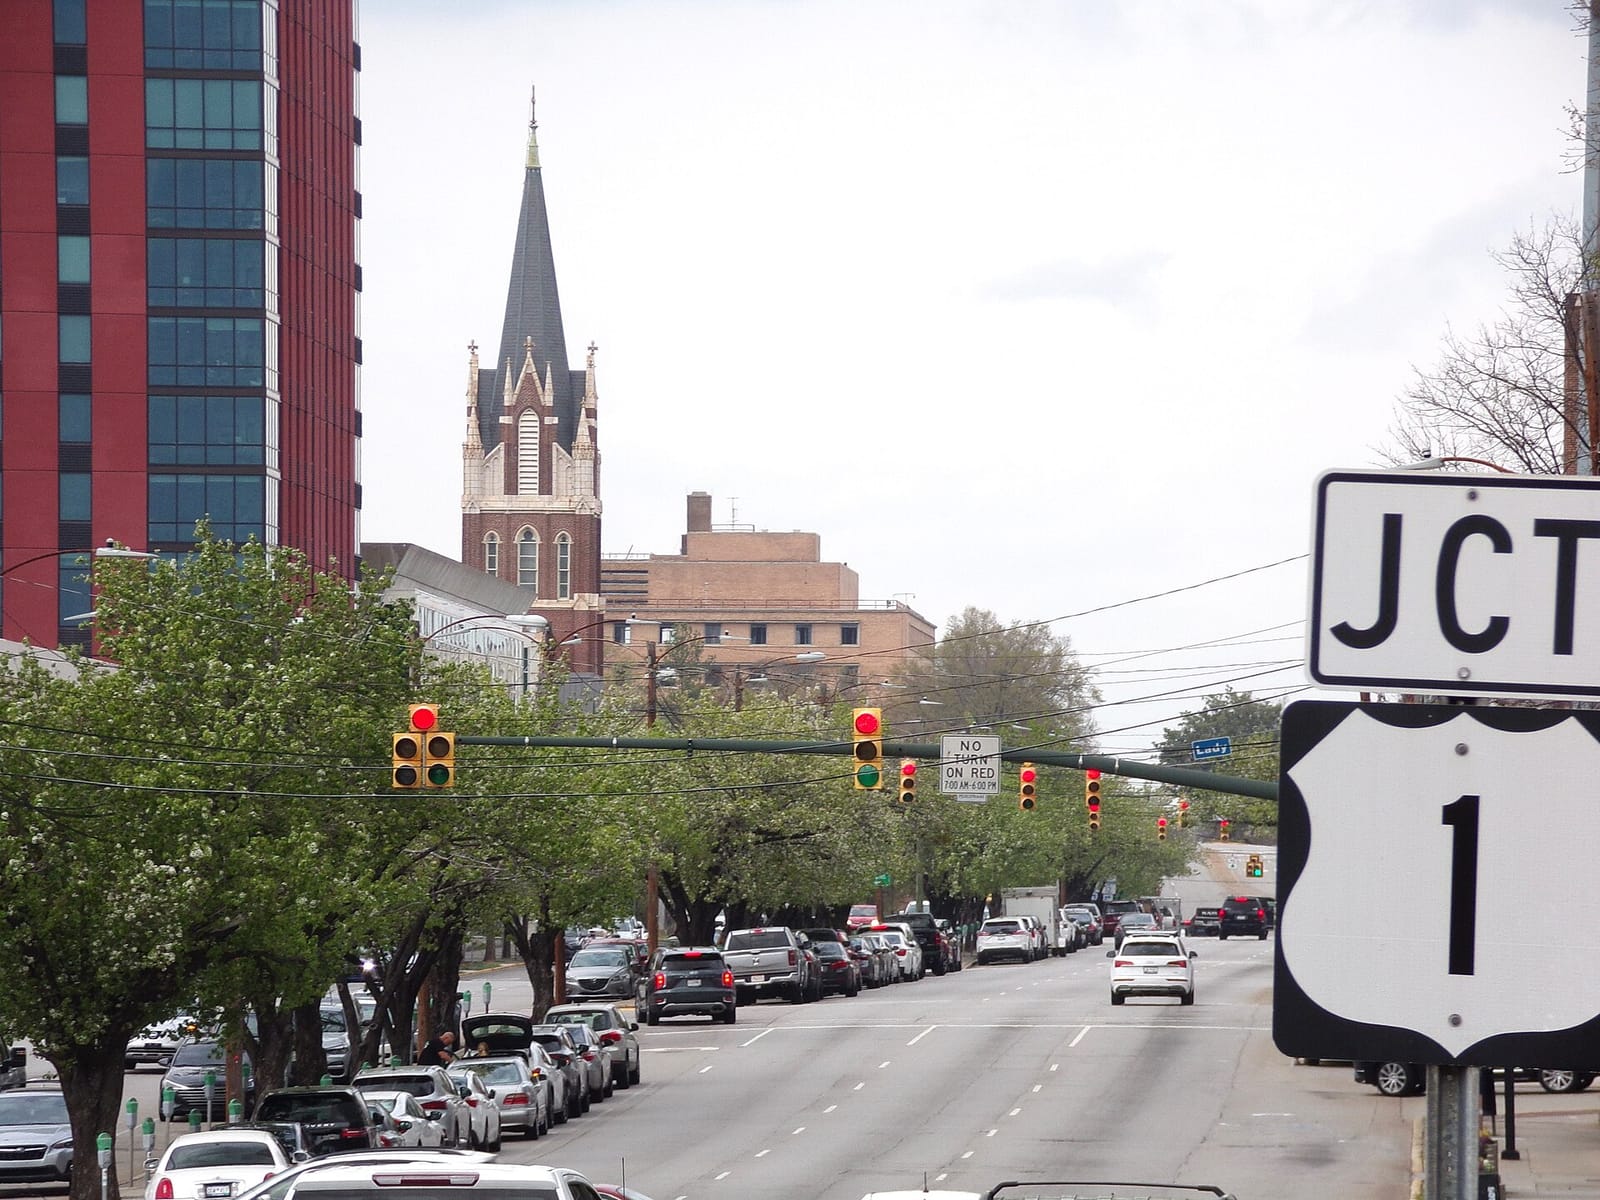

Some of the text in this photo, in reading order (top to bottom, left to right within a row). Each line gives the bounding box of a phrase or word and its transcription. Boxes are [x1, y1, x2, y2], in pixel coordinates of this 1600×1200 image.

[1329, 513, 1600, 655] JCT
[960, 740, 981, 751] NO
[1196, 743, 1227, 755] Lady
[954, 754, 988, 764] TURN
[946, 767, 995, 778] ON RED
[987, 781, 997, 790] PM
[1441, 795, 1480, 975] 1
